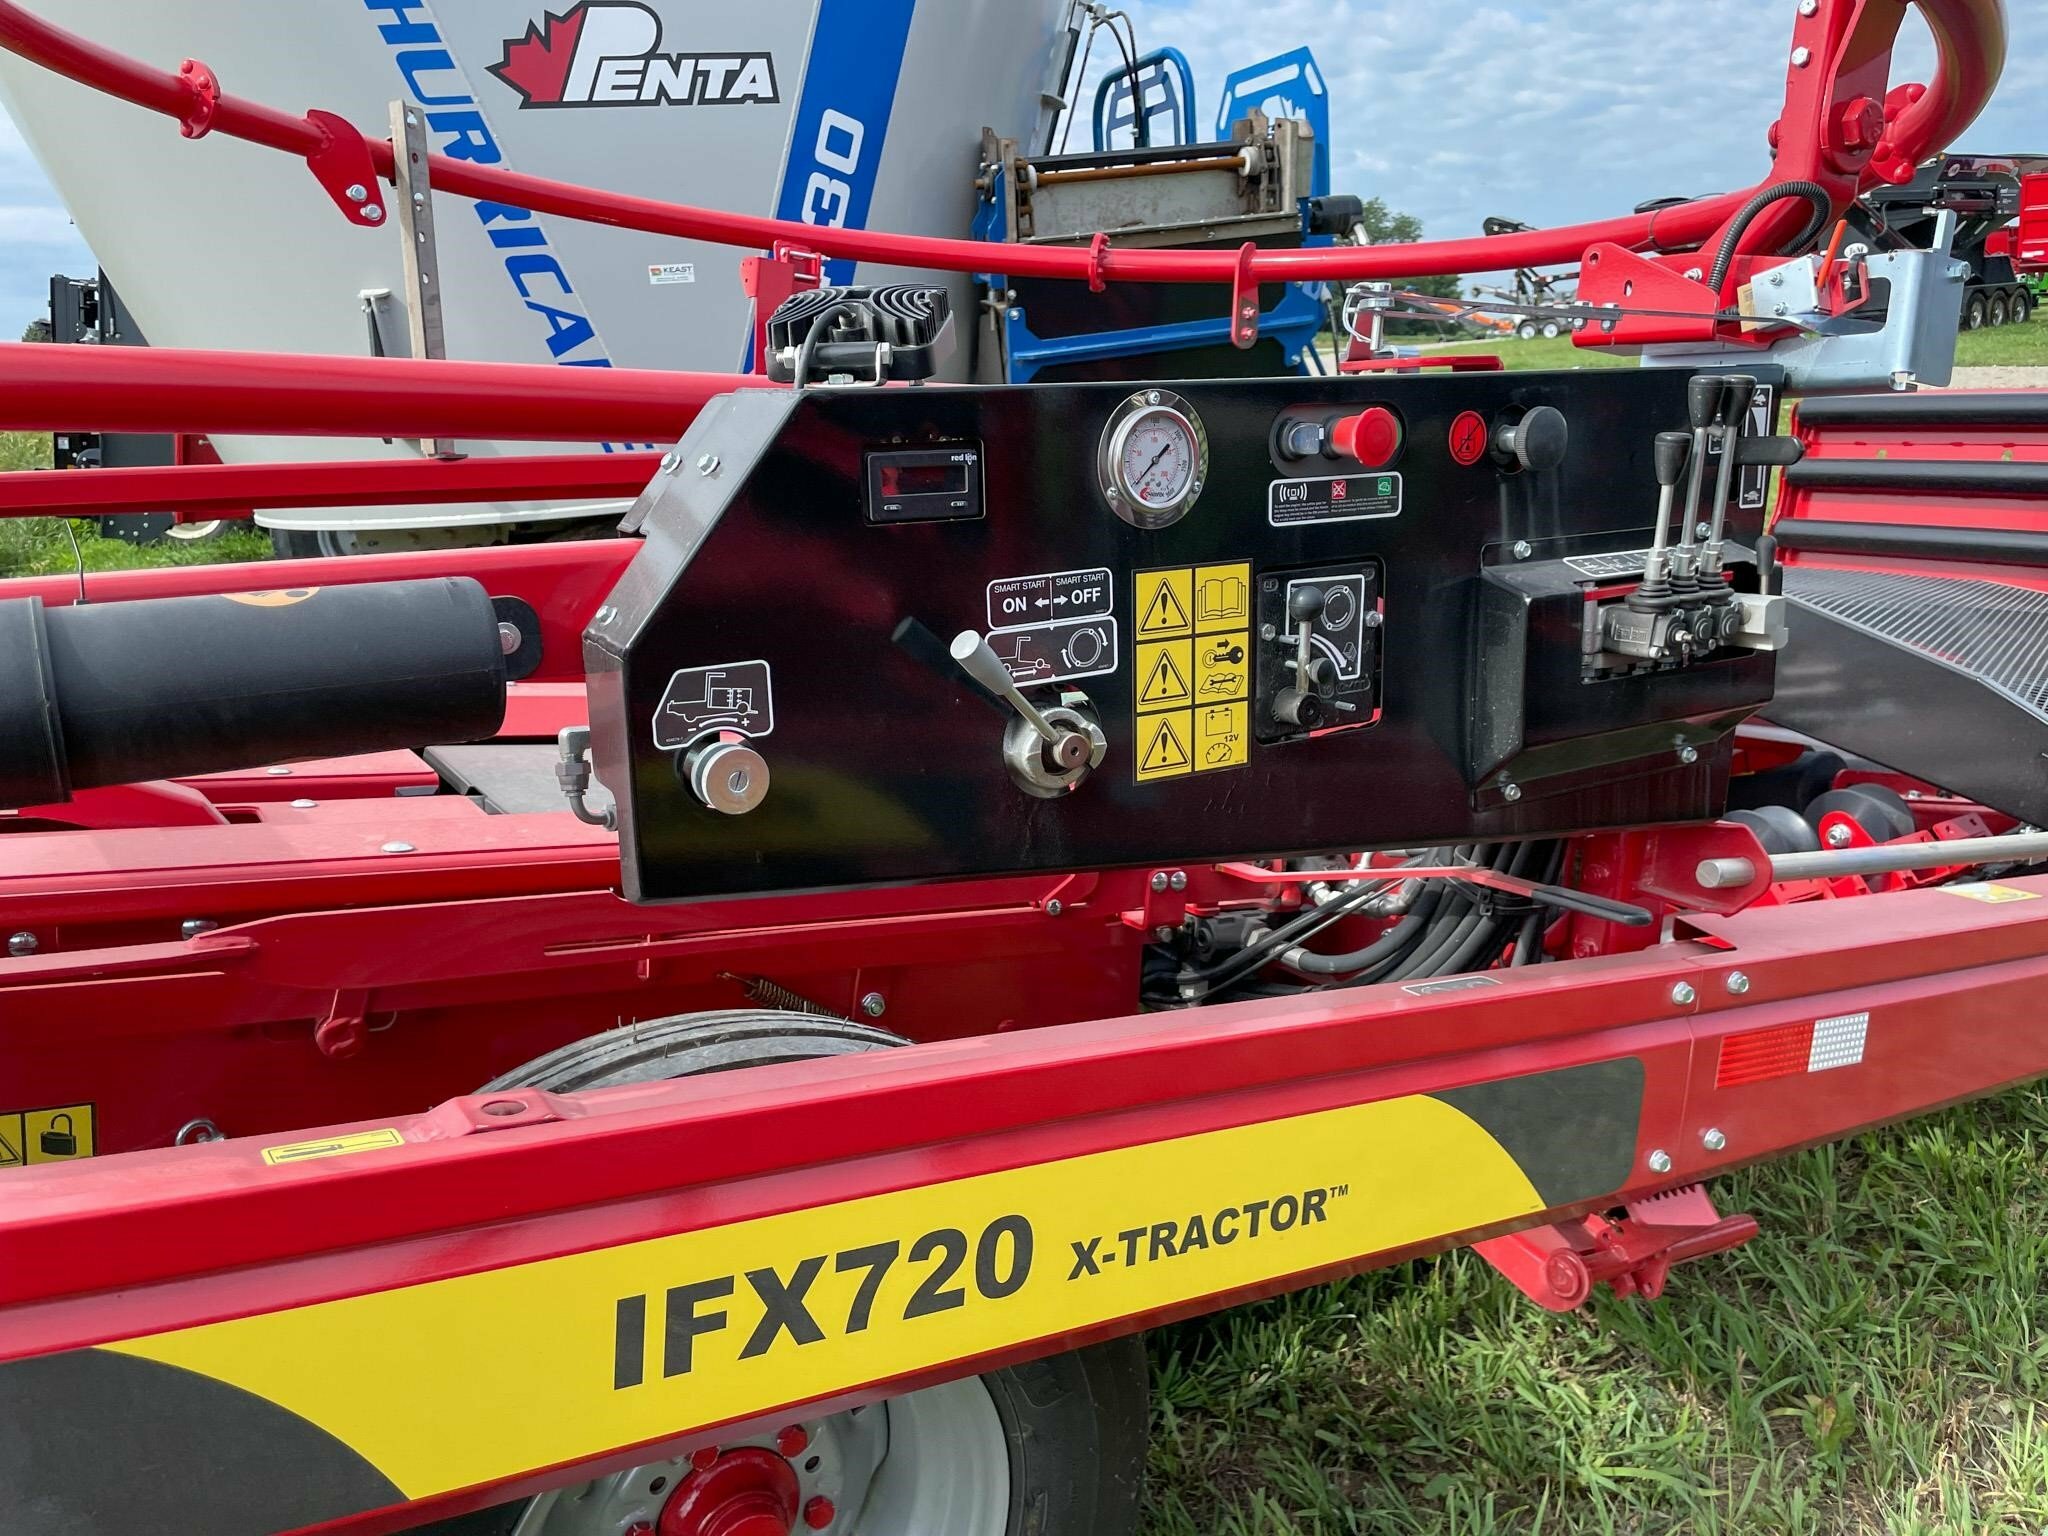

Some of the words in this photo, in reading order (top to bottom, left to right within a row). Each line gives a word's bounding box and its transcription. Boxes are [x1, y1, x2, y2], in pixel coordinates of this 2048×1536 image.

[561, 5, 775, 102] PENTA
[663, 265, 693, 273] KEAST
[951, 453, 963, 462] red
[994, 582, 1021, 594] SMART
[1022, 579, 1046, 590] START
[1055, 575, 1081, 586] SMART
[1082, 572, 1105, 583] START
[1071, 587, 1102, 604] OFF
[1002, 596, 1027, 613] ON
[1224, 733, 1239, 742] 12V
[615, 1215, 1034, 1390] IFX720
